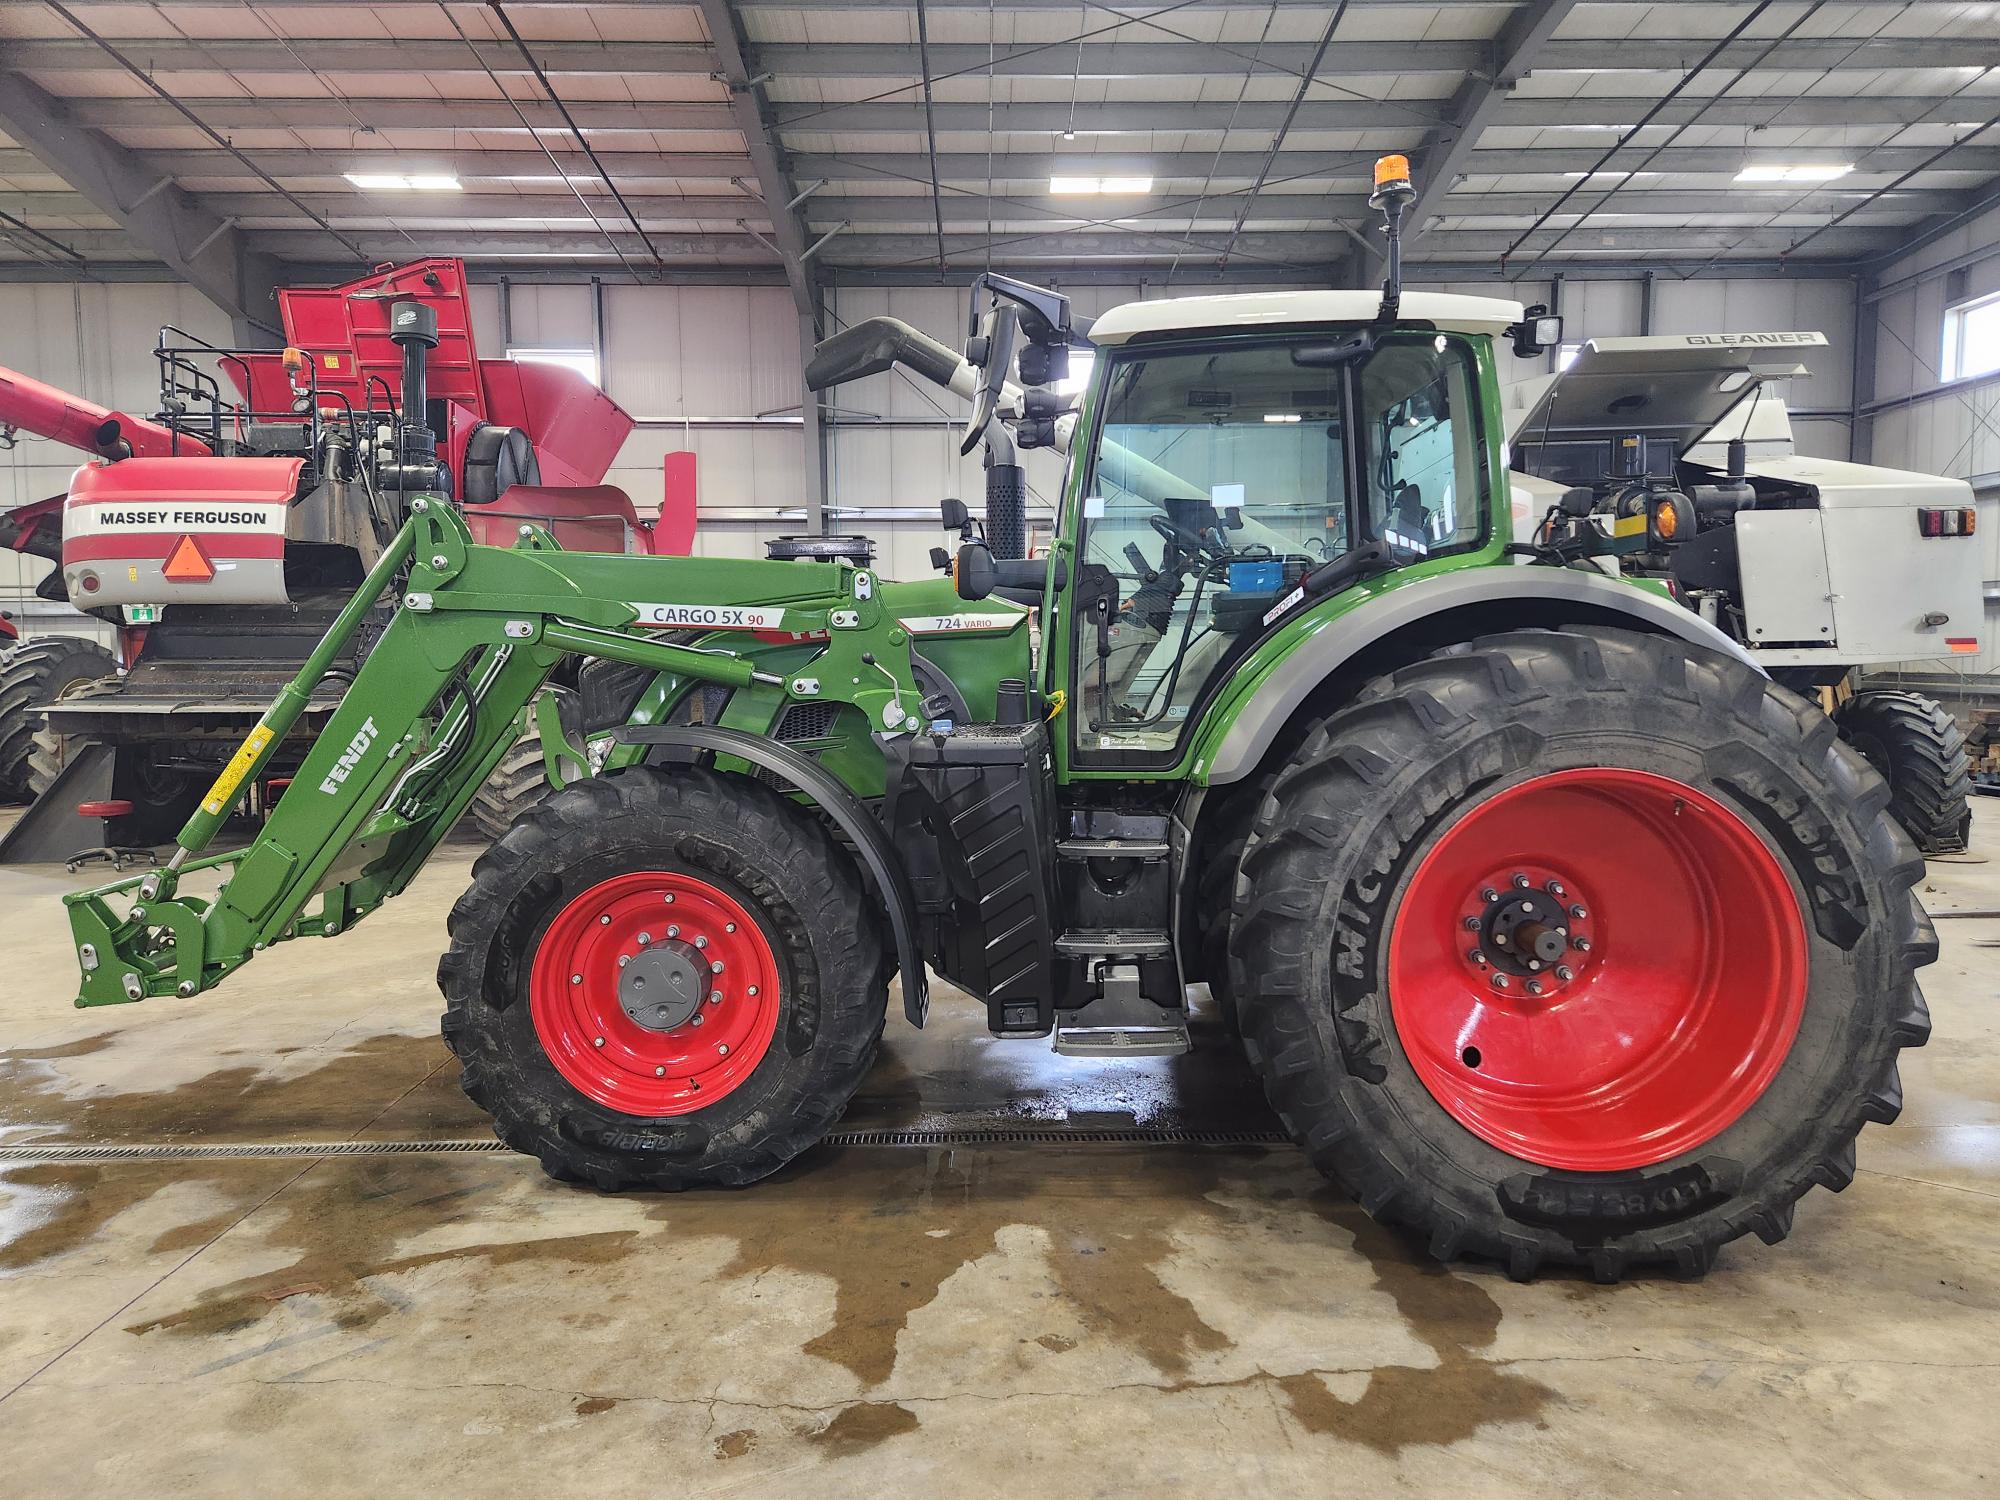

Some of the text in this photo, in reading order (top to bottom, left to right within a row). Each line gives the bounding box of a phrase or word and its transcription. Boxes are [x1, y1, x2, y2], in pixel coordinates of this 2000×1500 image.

[1686, 333, 1816, 345] GLEANER
[100, 511, 266, 525] MASSEY FERGUSON
[653, 607, 764, 626] CARGO 5X 90
[935, 618, 993, 630] 724 VARIO
[318, 715, 380, 796] FENDT
[1336, 736, 1503, 980] MICHELIN
